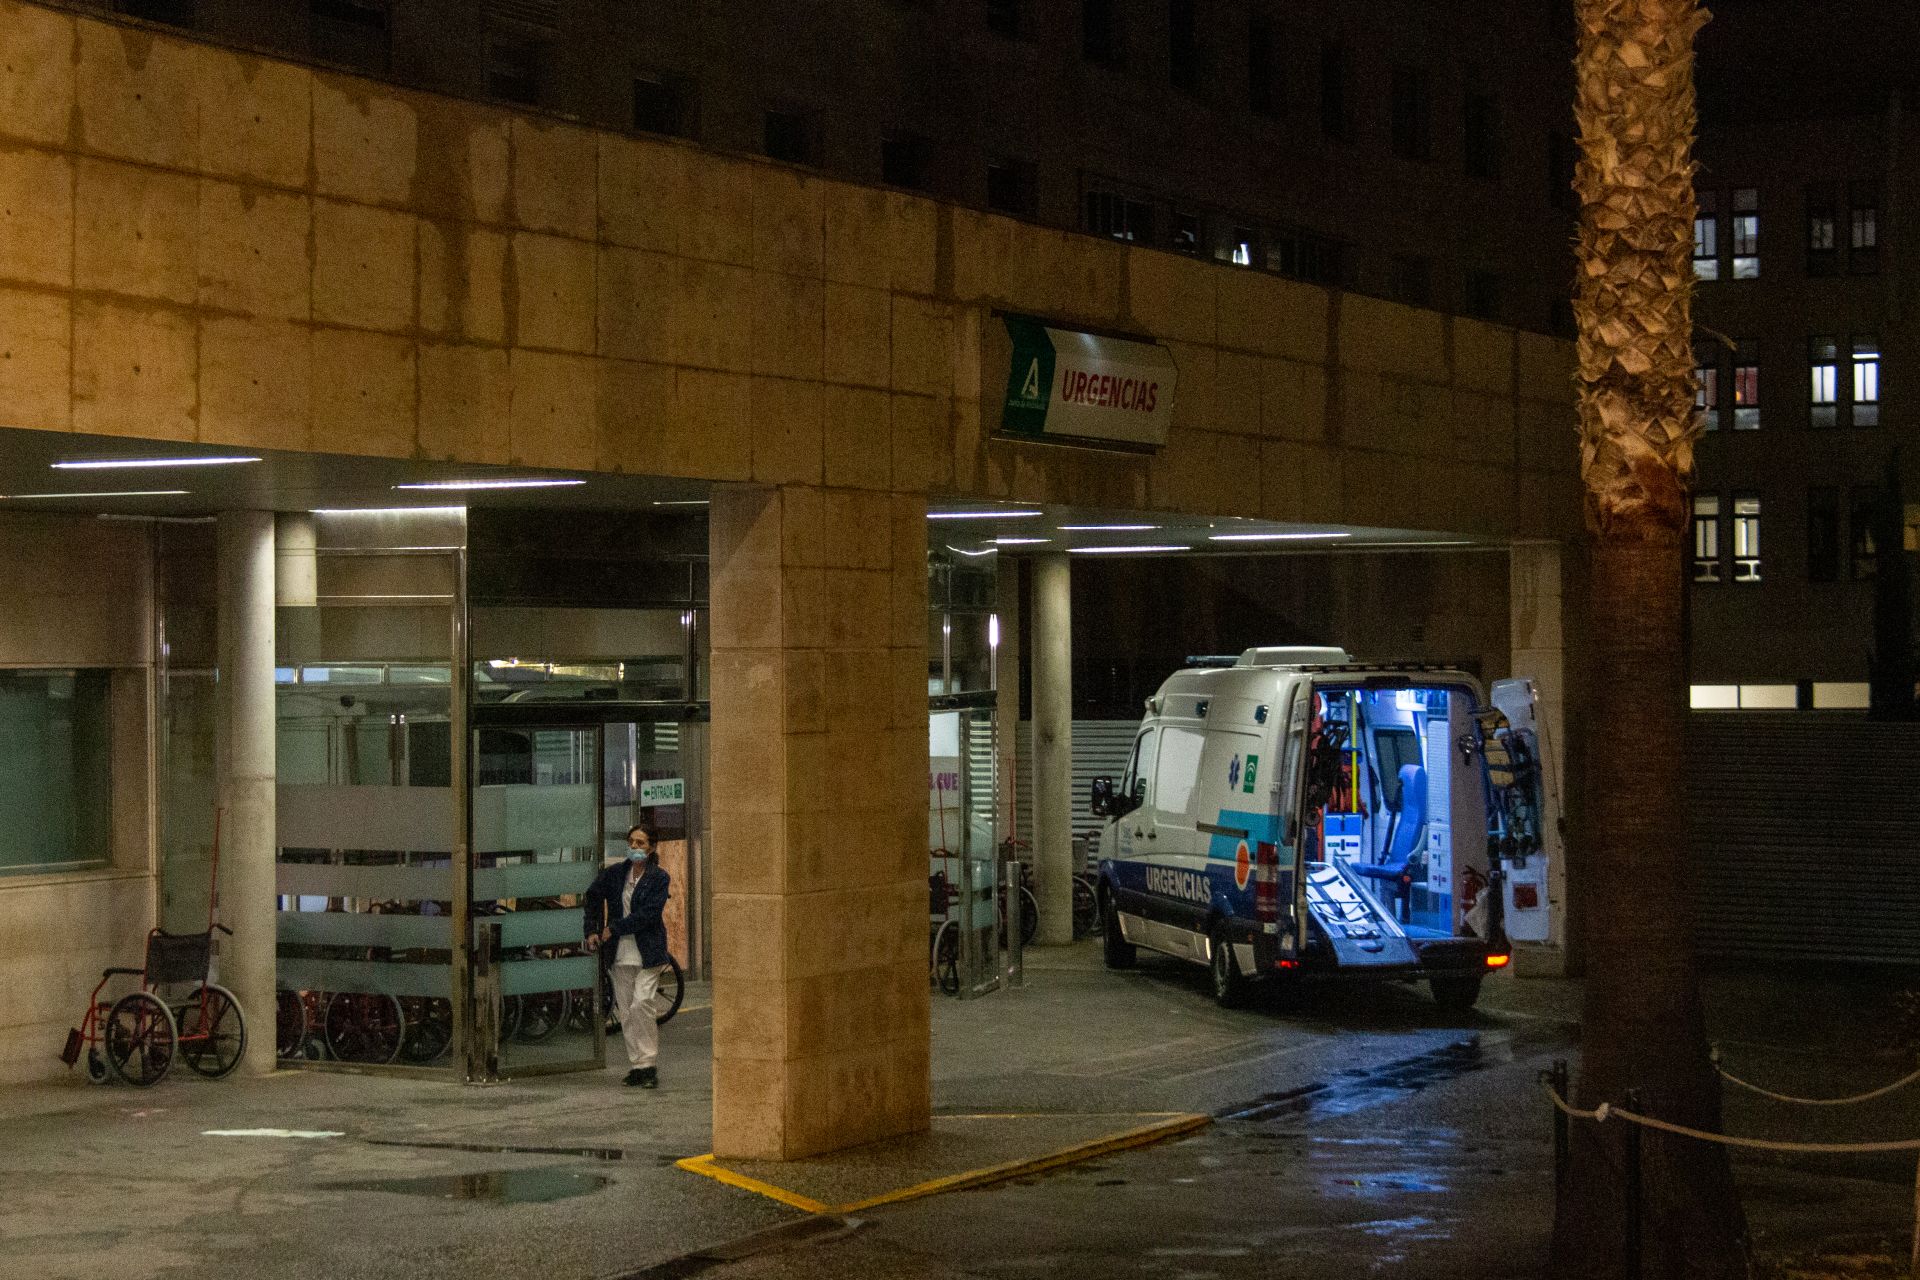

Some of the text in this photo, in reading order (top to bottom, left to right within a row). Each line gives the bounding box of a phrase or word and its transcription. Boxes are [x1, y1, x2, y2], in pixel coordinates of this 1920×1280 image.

[1063, 370, 1158, 412] URGENCIAS
[651, 784, 673, 800] ENTRADA
[1146, 866, 1212, 904] URGENCIAS
